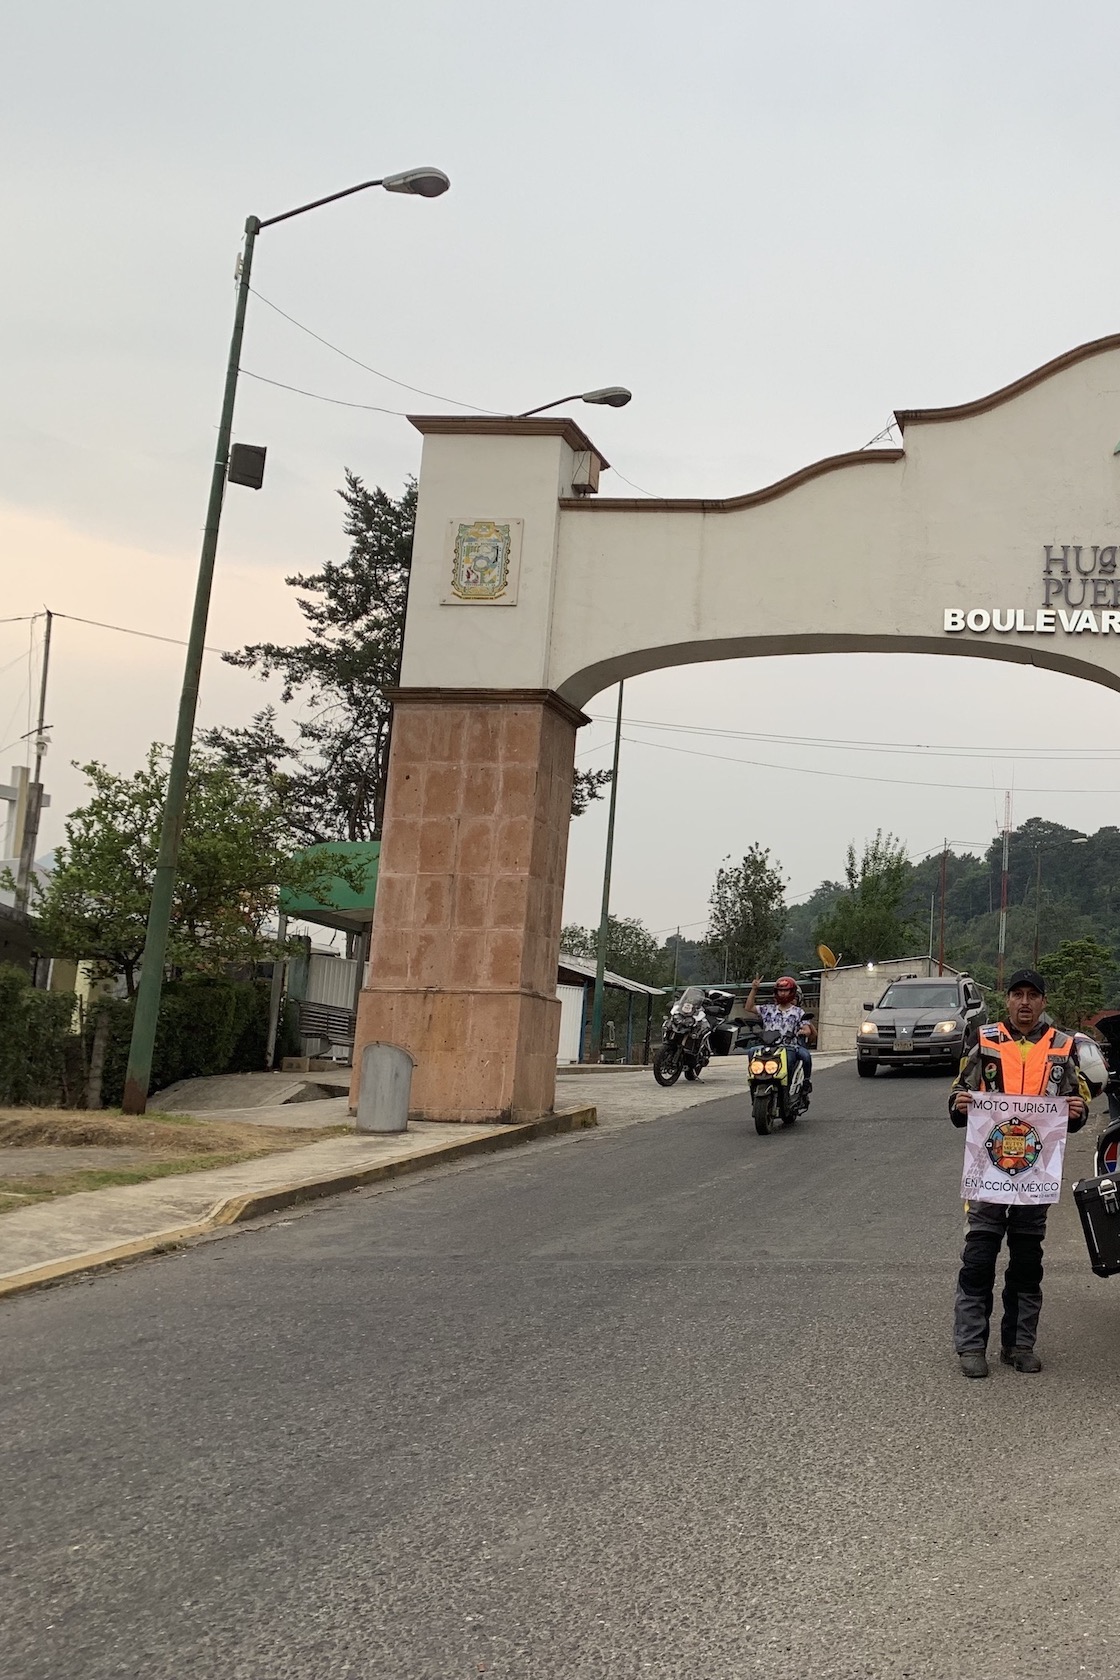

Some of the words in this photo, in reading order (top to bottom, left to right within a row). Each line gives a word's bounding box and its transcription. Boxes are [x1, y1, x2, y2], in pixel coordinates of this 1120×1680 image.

[973, 1100, 1009, 1112] MOTO
[1012, 1102, 1058, 1113] TURISTA
[965, 1178, 978, 1188] EN
[979, 1179, 1019, 1192] ACCIÓN
[1021, 1181, 1059, 1192] MÉXICO
